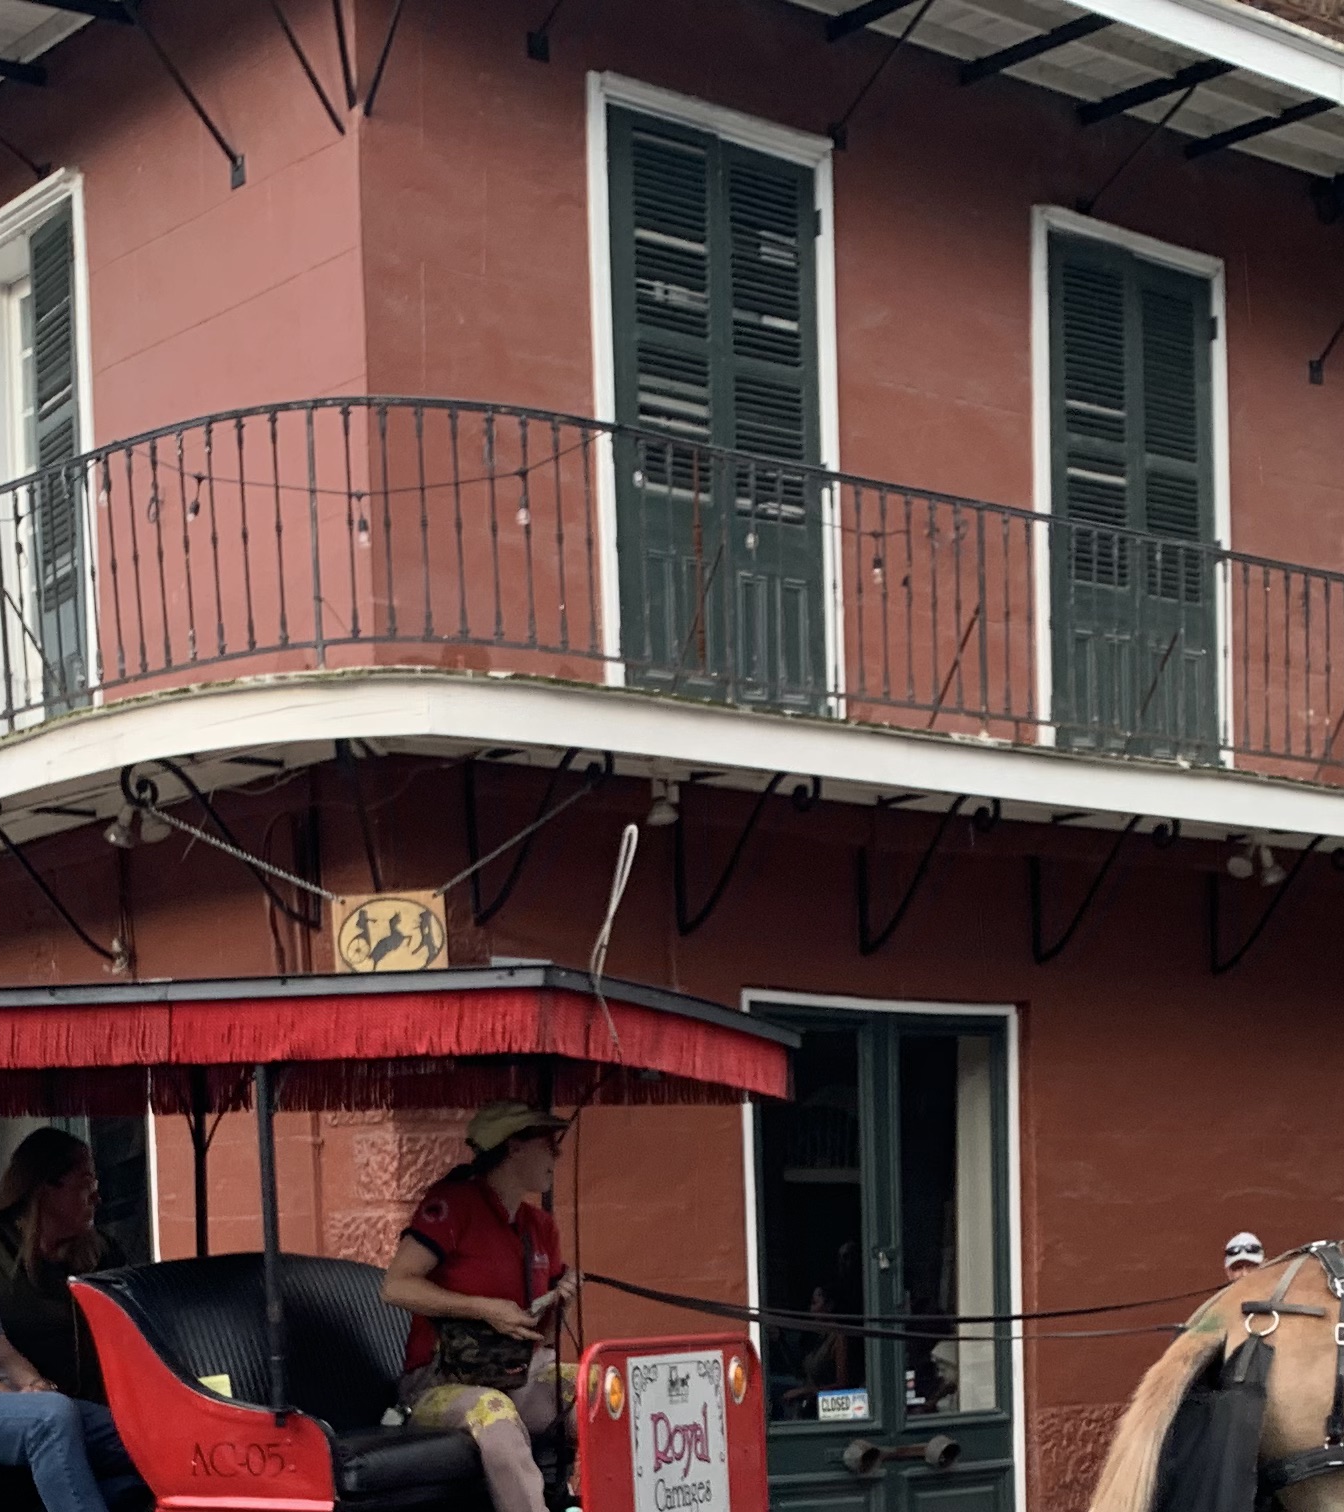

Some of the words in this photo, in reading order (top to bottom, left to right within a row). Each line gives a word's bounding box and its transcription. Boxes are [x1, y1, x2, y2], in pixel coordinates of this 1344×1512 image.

[821, 1396, 850, 1412] CLOSED
[651, 1402, 710, 1474] Royal
[191, 1442, 285, 1478] AC-05
